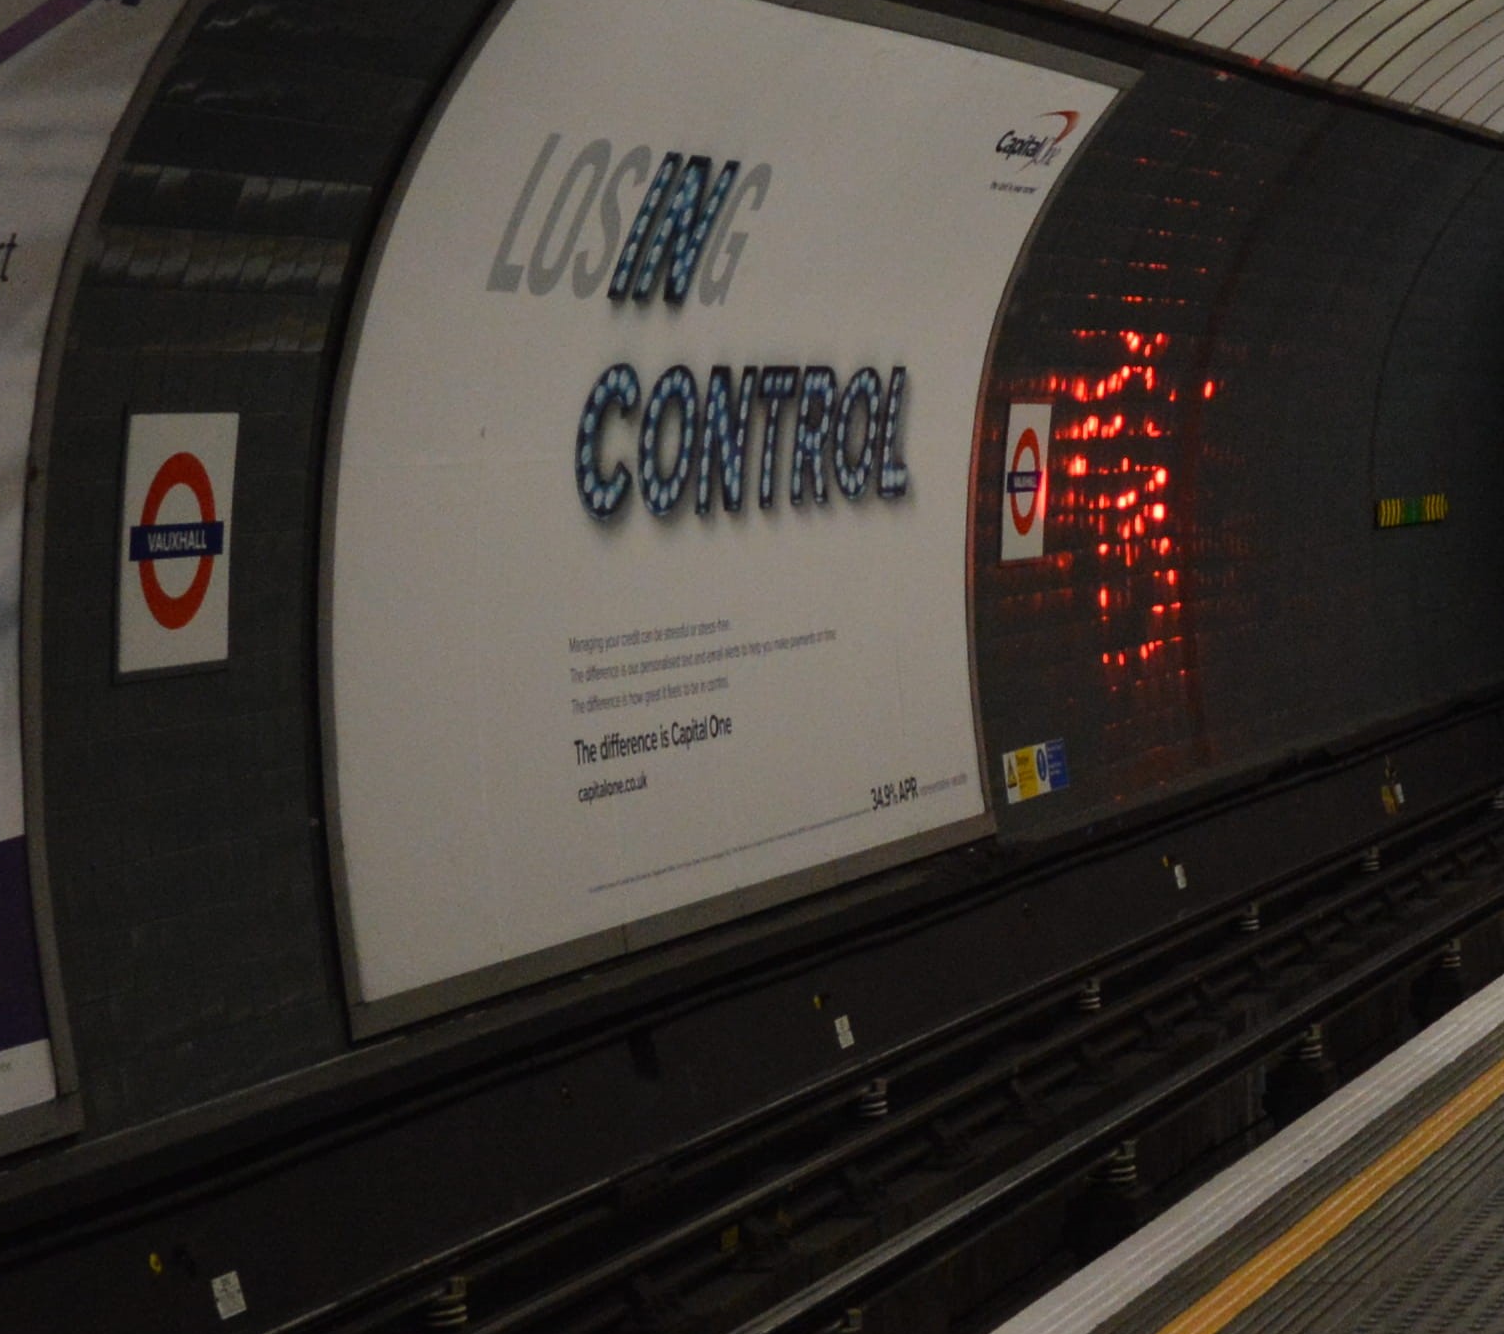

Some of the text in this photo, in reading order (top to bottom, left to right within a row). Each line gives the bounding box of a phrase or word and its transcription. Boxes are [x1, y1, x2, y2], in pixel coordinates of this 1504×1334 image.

[485, 130, 775, 308] LOSING
[576, 362, 909, 523] CONTROL
[146, 529, 209, 553] VAUXHALL
[574, 714, 733, 766] The difference is Capital One
[577, 771, 648, 806] capitalone.co.uk
[898, 776, 919, 802] APR
